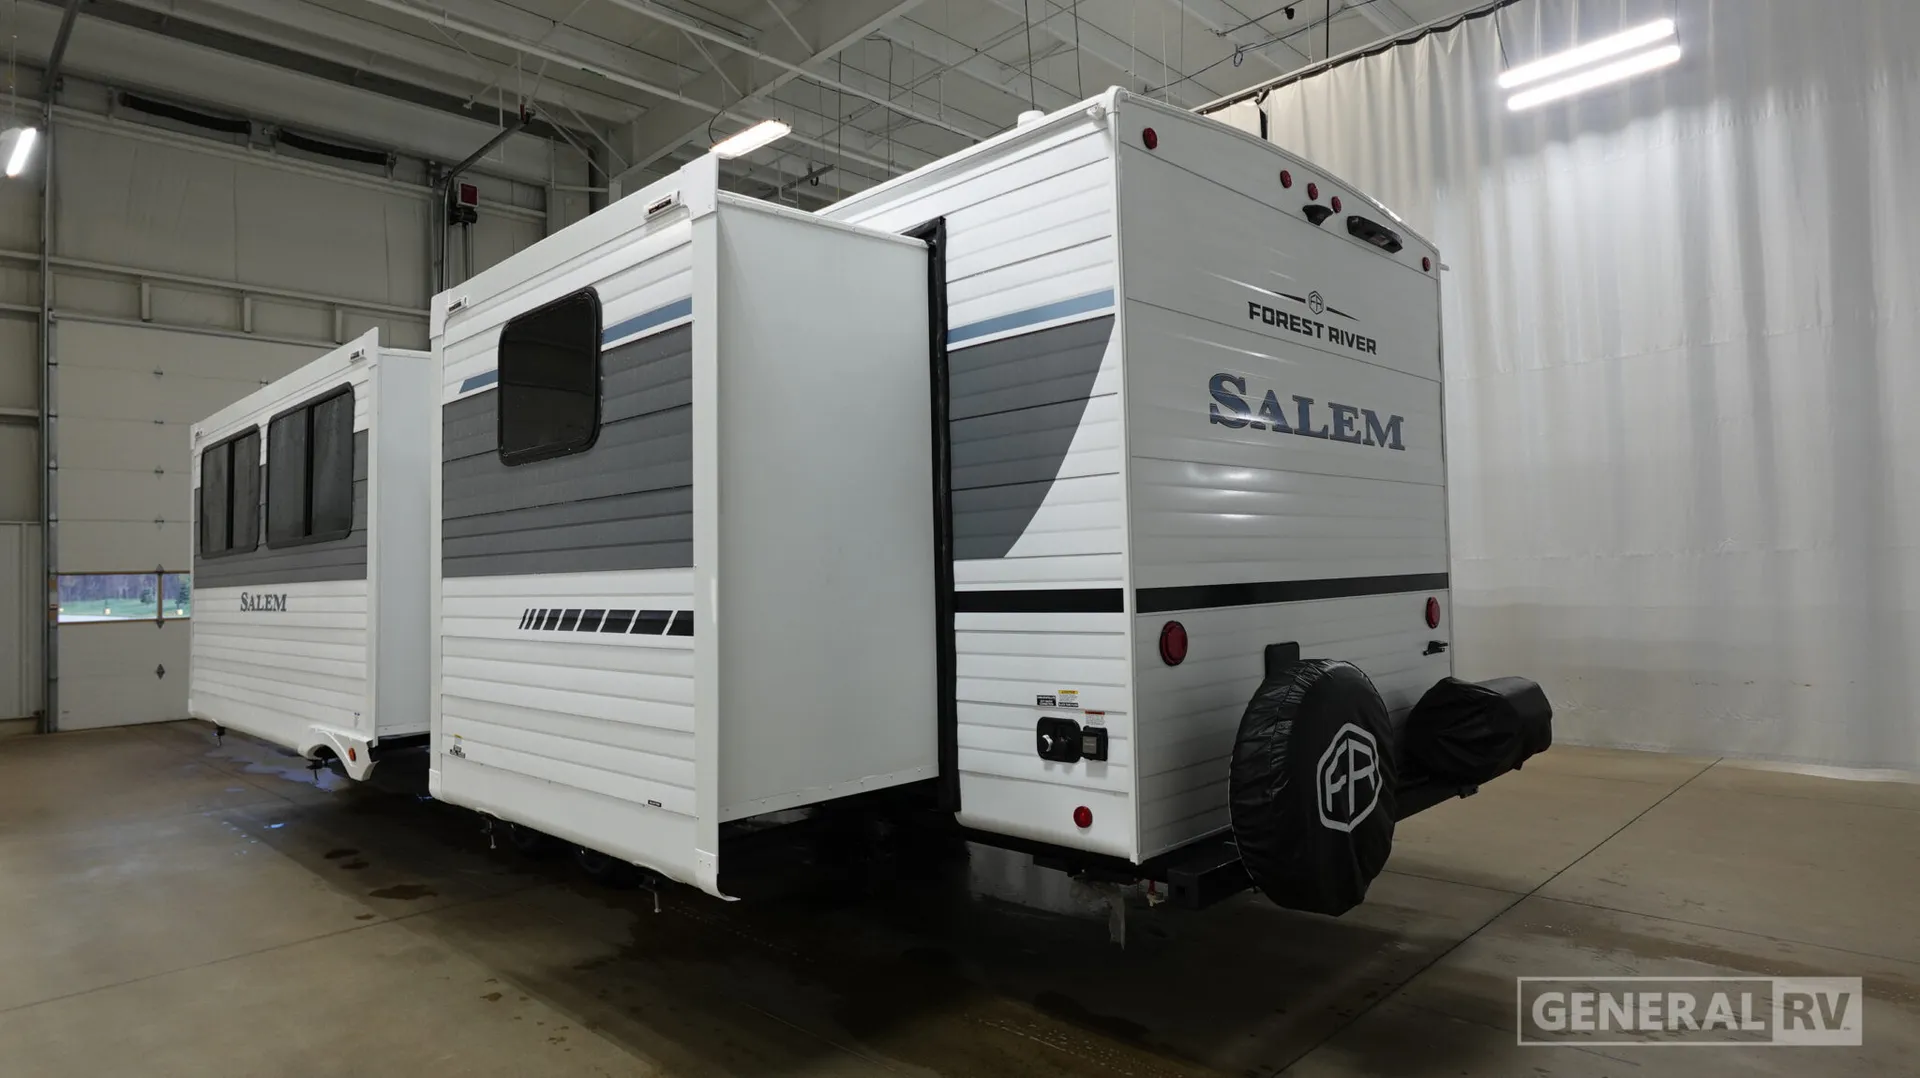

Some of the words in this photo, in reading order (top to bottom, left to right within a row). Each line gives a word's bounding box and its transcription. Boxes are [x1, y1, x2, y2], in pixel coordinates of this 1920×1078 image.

[1248, 301, 1324, 339] FOREST
[1328, 325, 1377, 355] RIVER
[1208, 372, 1406, 451] SALEM
[240, 591, 287, 612] SALEM
